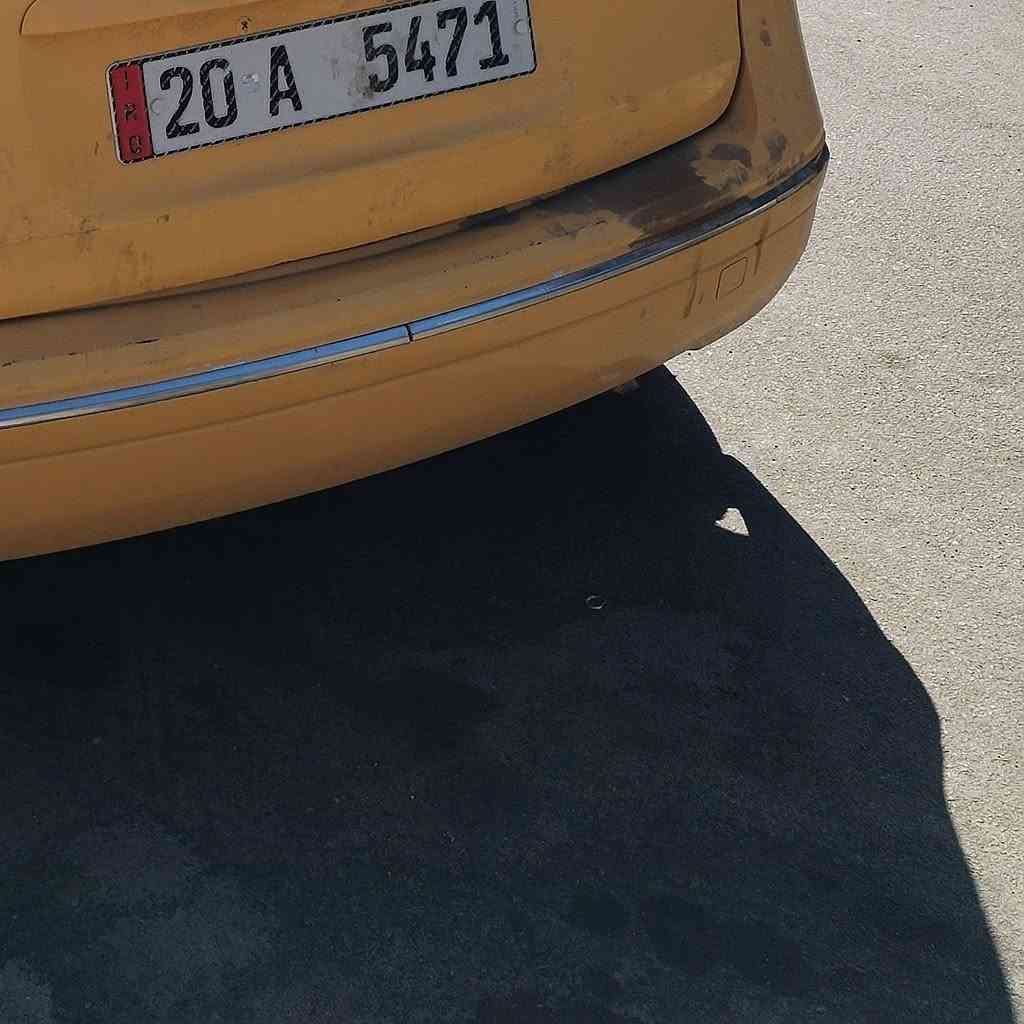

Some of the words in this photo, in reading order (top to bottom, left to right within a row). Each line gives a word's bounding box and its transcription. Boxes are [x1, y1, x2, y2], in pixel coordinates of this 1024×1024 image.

[159, 57, 239, 139] 20
[268, 45, 303, 116] A
[361, 0, 510, 93] 5471
